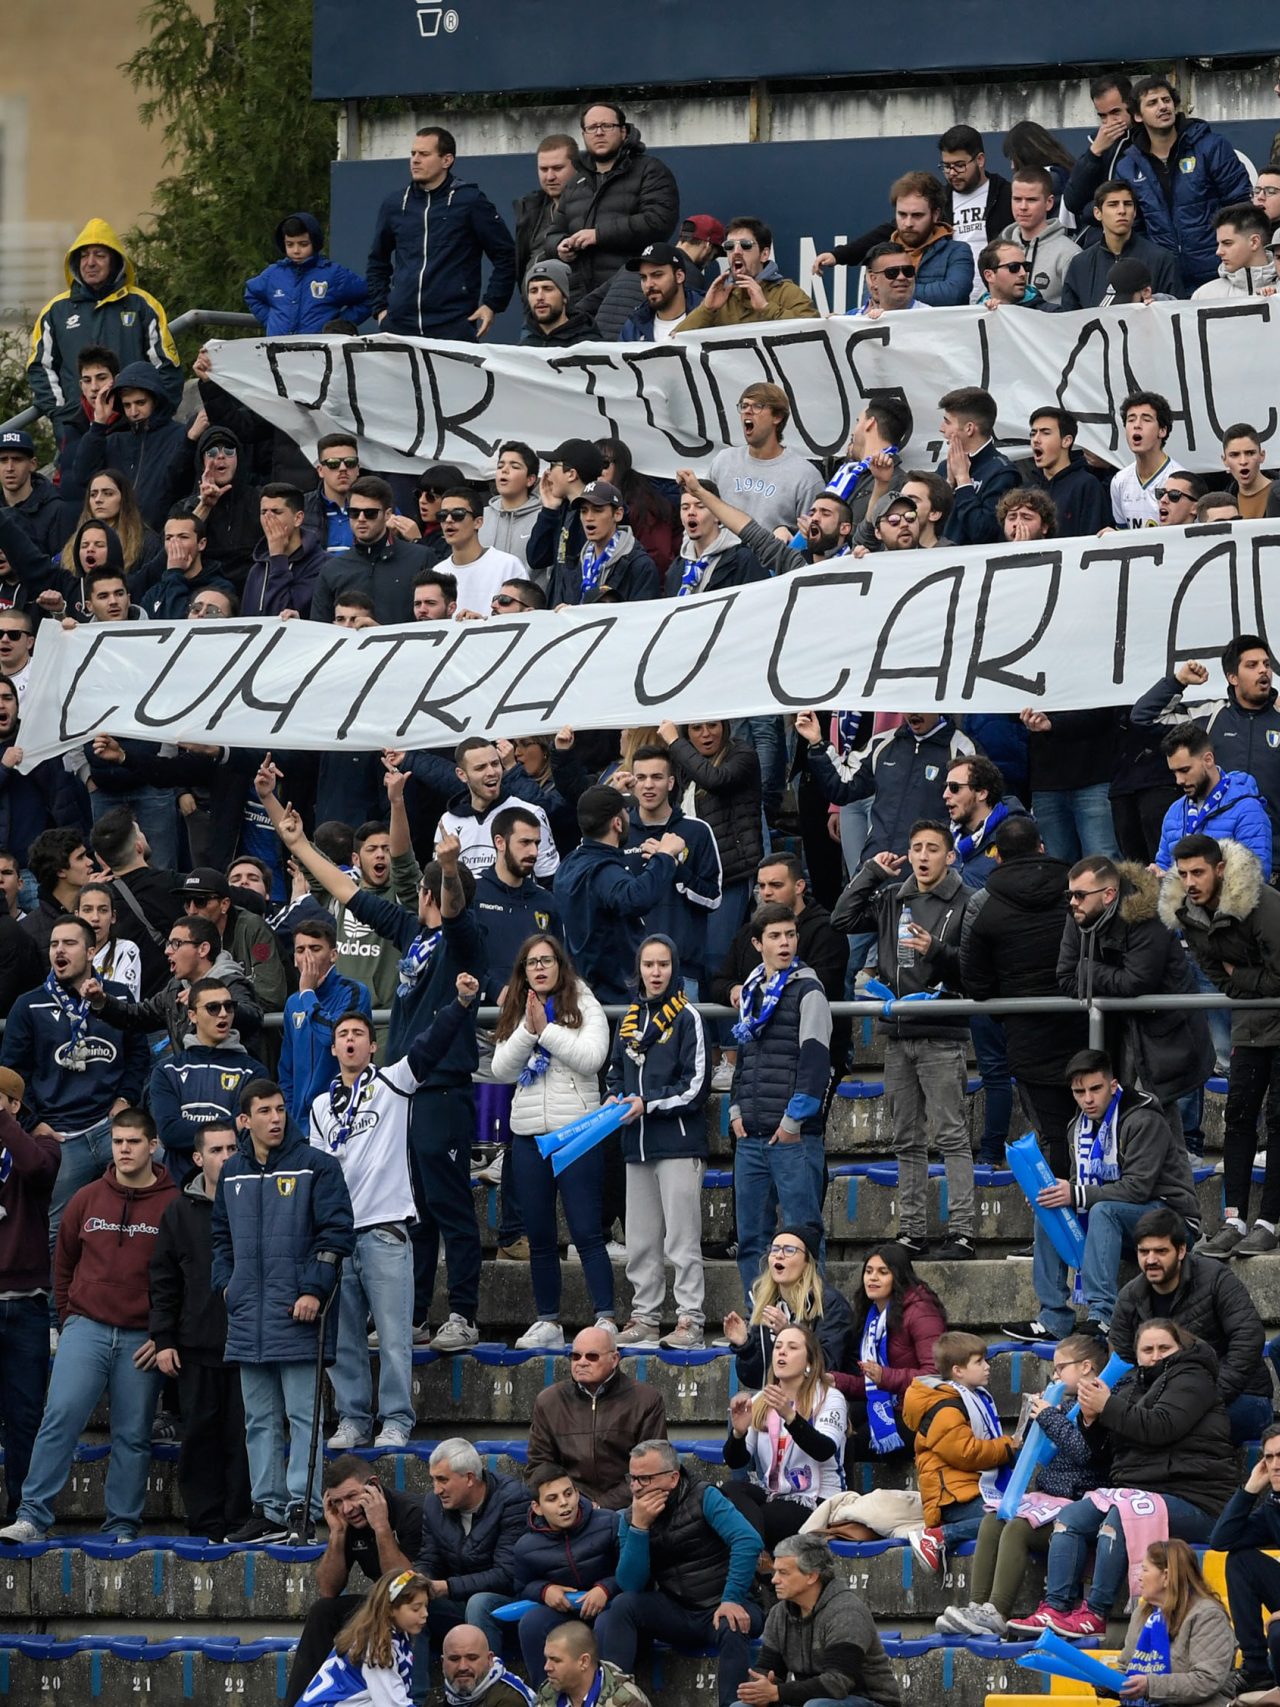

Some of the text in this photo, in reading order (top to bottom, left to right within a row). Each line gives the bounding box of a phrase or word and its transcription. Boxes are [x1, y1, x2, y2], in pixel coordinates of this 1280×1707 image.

[264, 340, 502, 460] POR
[3, 433, 21, 442] 1931
[734, 477, 777, 498] 1990
[59, 615, 618, 742] CONTRA
[633, 591, 741, 708] O
[84, 1217, 160, 1238] Champion
[677, 1382, 699, 1398] 22
[71, 1476, 92, 1493] 17
[848, 1573, 870, 1589] 27
[944, 1573, 966, 1589] 28
[40, 1675, 62, 1692] 20
[132, 1676, 152, 1692] 21
[224, 1677, 245, 1694] 22
[695, 1673, 716, 1689] 27
